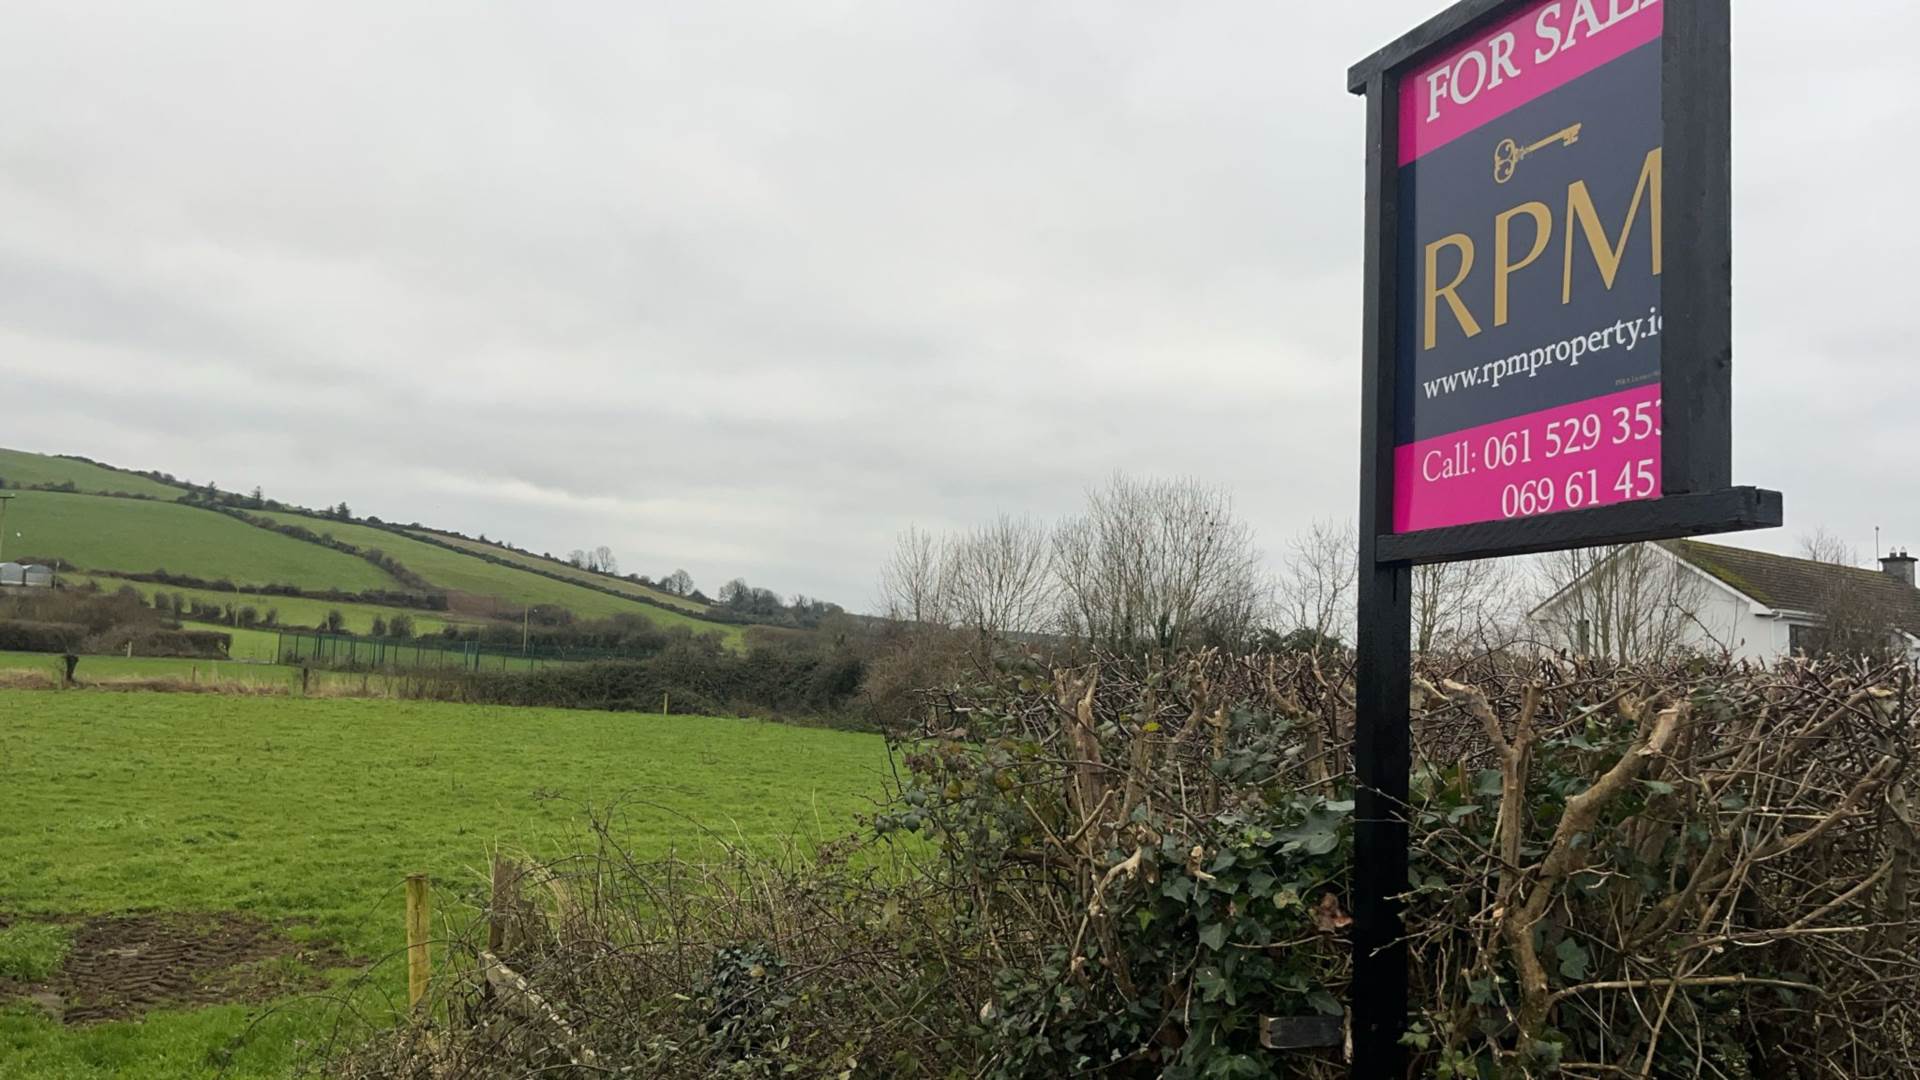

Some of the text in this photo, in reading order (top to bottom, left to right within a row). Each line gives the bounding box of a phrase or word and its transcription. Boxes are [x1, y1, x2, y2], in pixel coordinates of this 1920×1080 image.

[1426, 0, 1660, 123] FOR SAL
[1423, 147, 1661, 351] RPM
[1422, 442, 1477, 483] Call:
[1484, 429, 1532, 469] 061
[1545, 413, 1601, 458] 529
[1501, 478, 1555, 518] 069
[1564, 469, 1600, 508] 61
